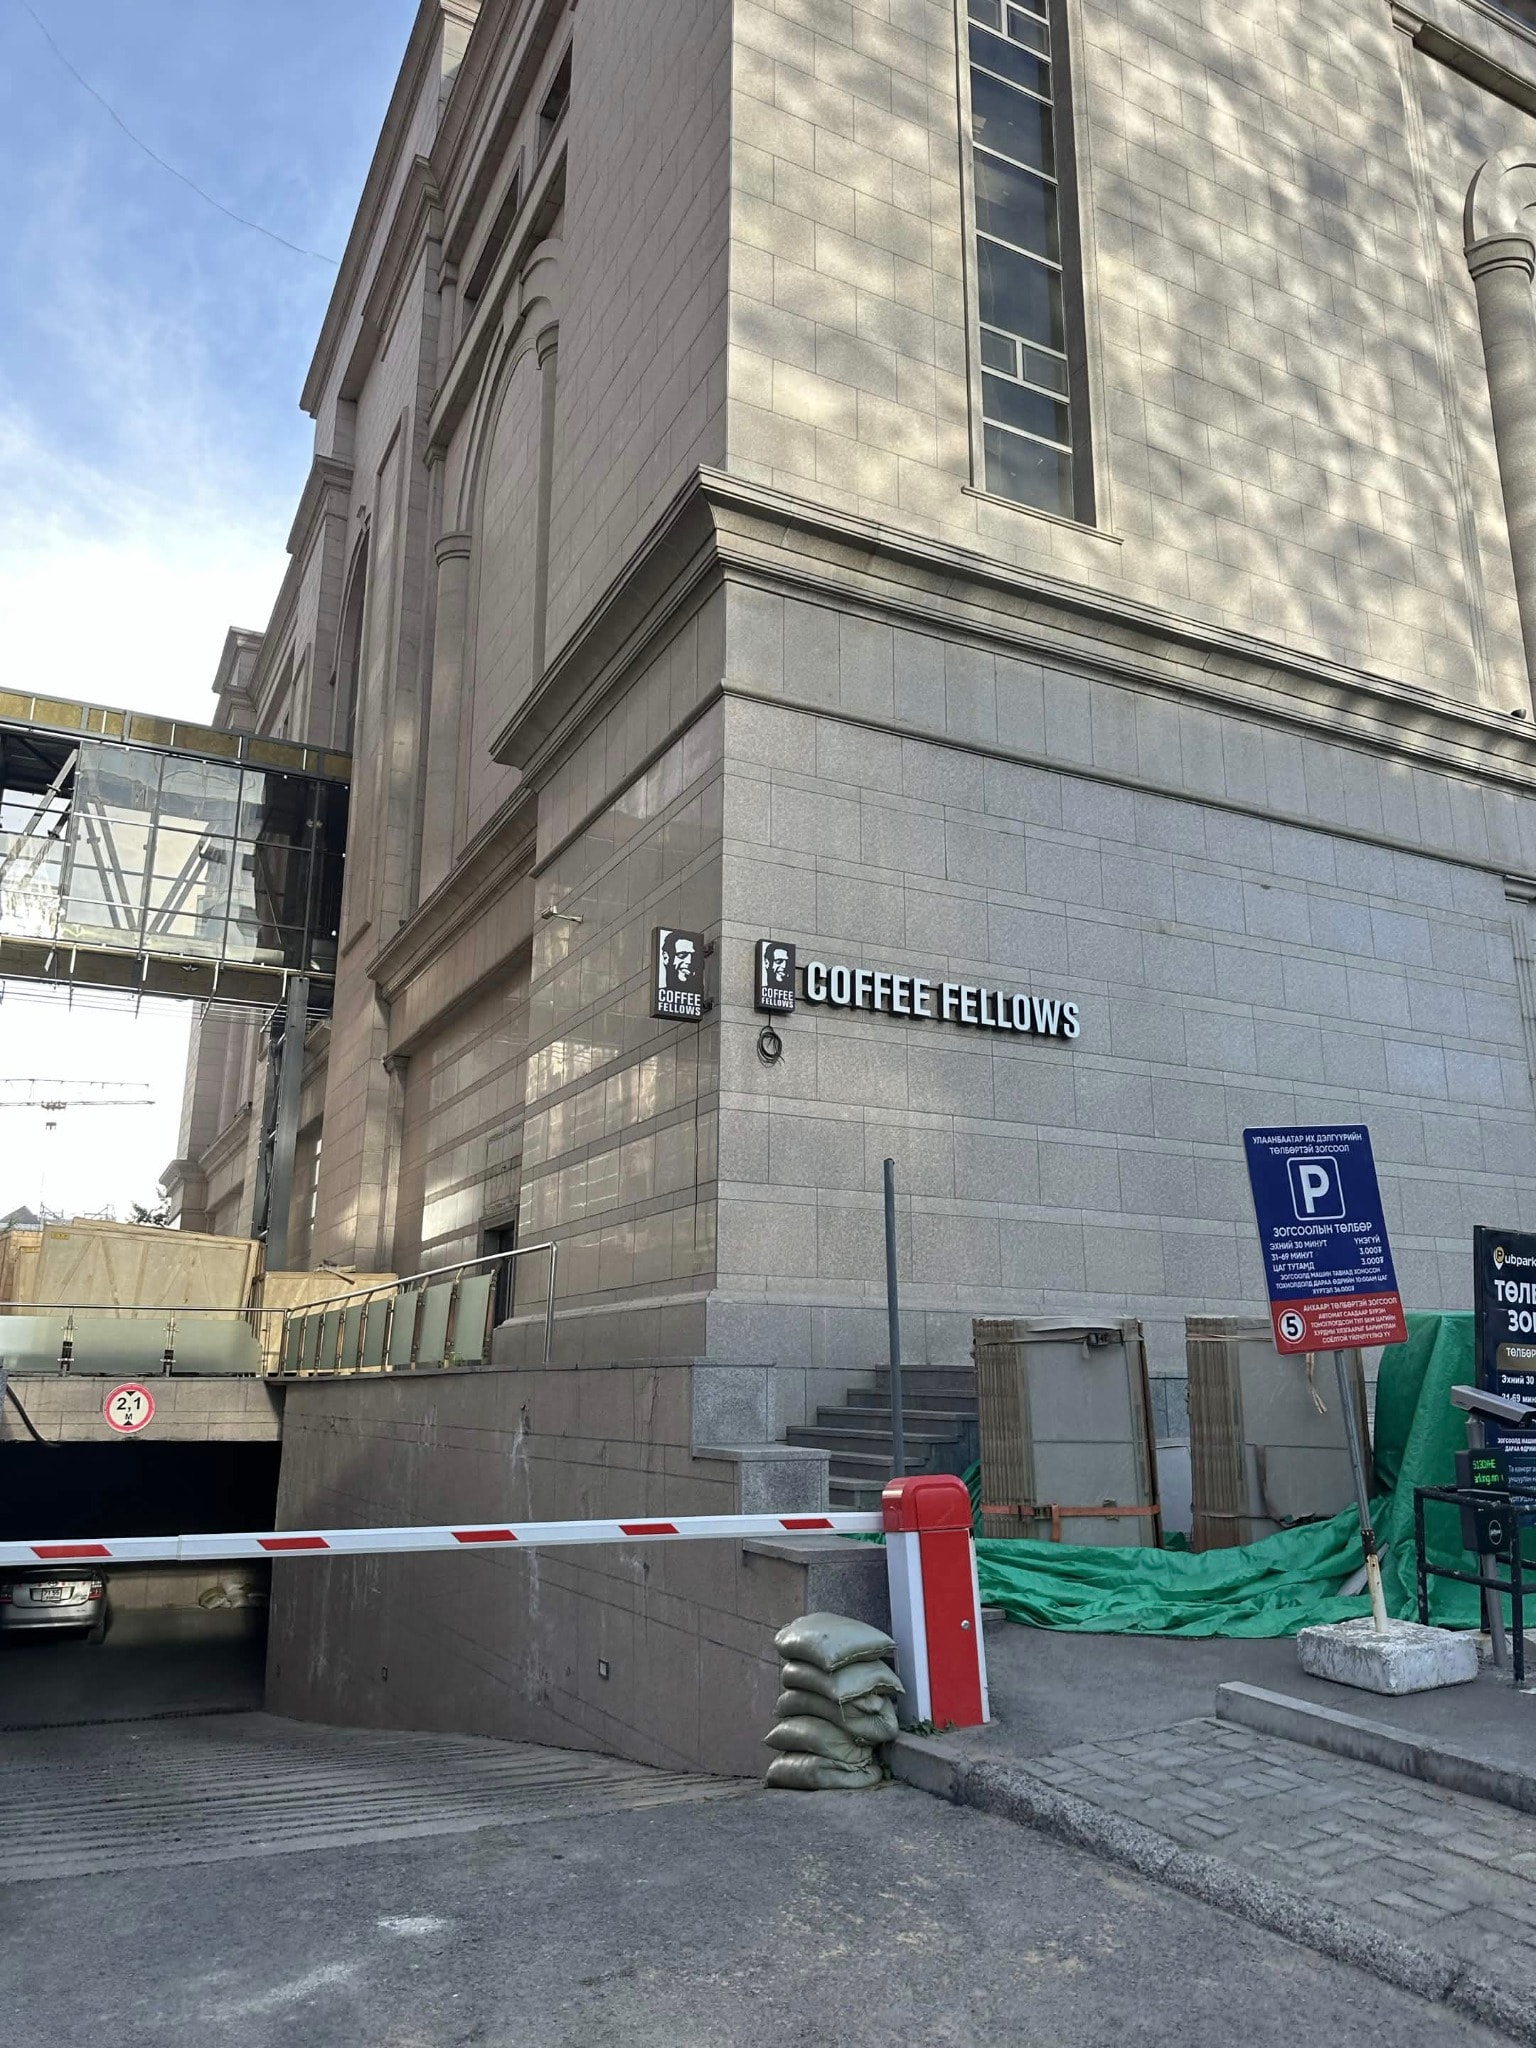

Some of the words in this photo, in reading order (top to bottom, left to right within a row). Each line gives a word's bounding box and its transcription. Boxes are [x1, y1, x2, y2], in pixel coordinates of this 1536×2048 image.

[659, 989, 701, 1006] COFFEE
[762, 988, 793, 1000] COFFEE
[808, 961, 931, 1016] COFFEE
[942, 983, 1080, 1038] FELLOWS
[762, 998, 793, 1008] FELLOWS
[659, 1002, 700, 1016] FELLOWS
[1252, 1135, 1302, 1144] УЛААНБААТАР
[1315, 1145, 1349, 1153] ЗОГСООЛ
[1299, 1165, 1329, 1214] P
[1273, 1224, 1333, 1237] ЗОГСООЛЫН
[1334, 1222, 1372, 1233] ТӨЛБӨР
[1270, 1240, 1293, 1250] ЭХНИЙ
[1304, 1240, 1327, 1248] МИНУТ
[1290, 1251, 1313, 1259] МИНУТ
[1273, 1264, 1286, 1272] ЦАГ
[1286, 1316, 1298, 1336] 5
[1526, 1375, 1535, 1385] 30
